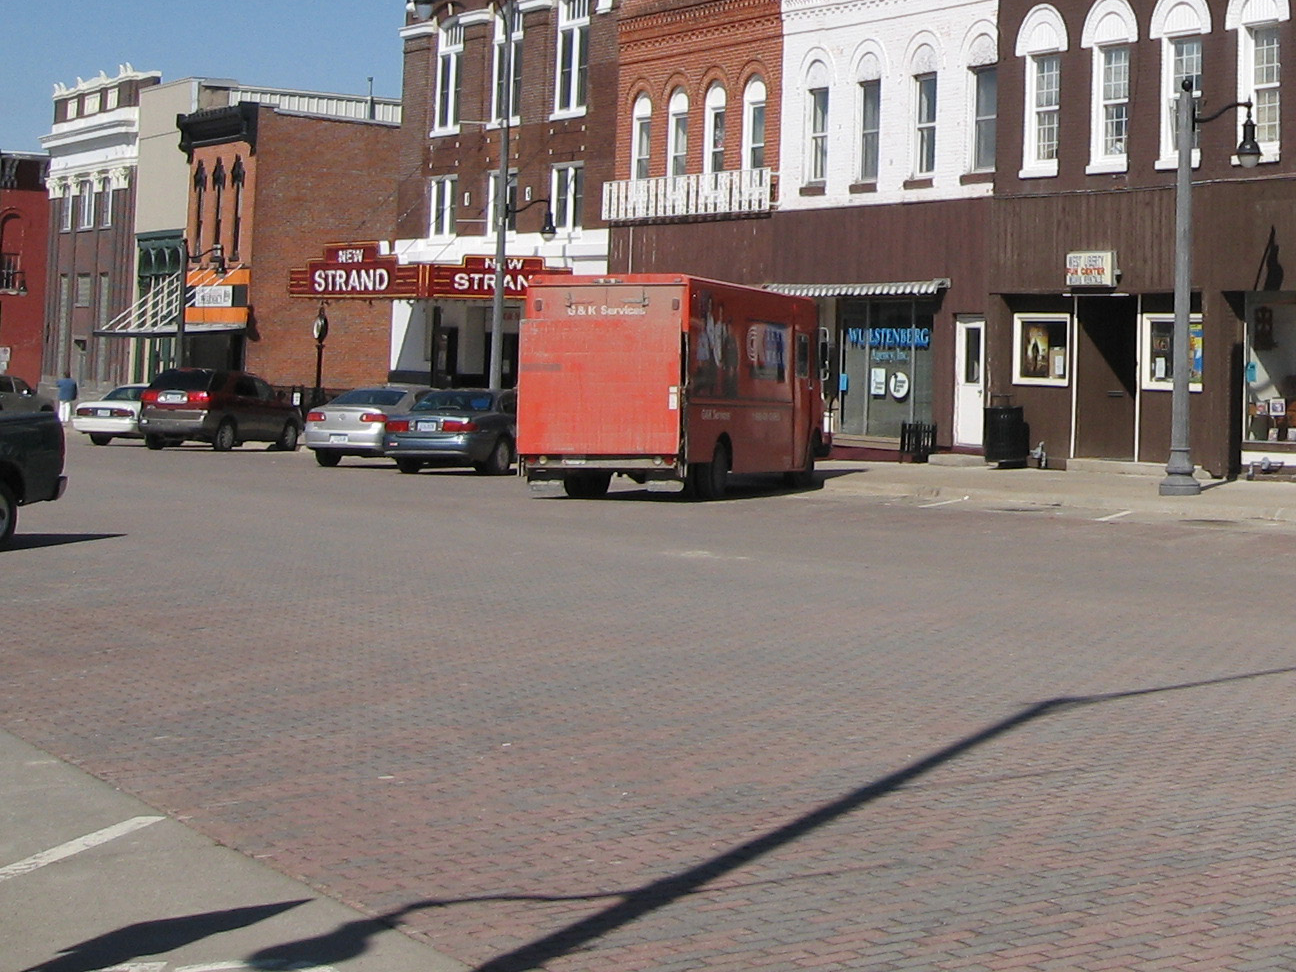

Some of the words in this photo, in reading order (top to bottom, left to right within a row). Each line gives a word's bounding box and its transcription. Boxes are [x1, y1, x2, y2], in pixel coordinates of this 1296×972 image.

[338, 249, 364, 263] NEW
[485, 257, 524, 270] NW
[314, 268, 390, 292] STRAND
[454, 272, 533, 291] STRAN
